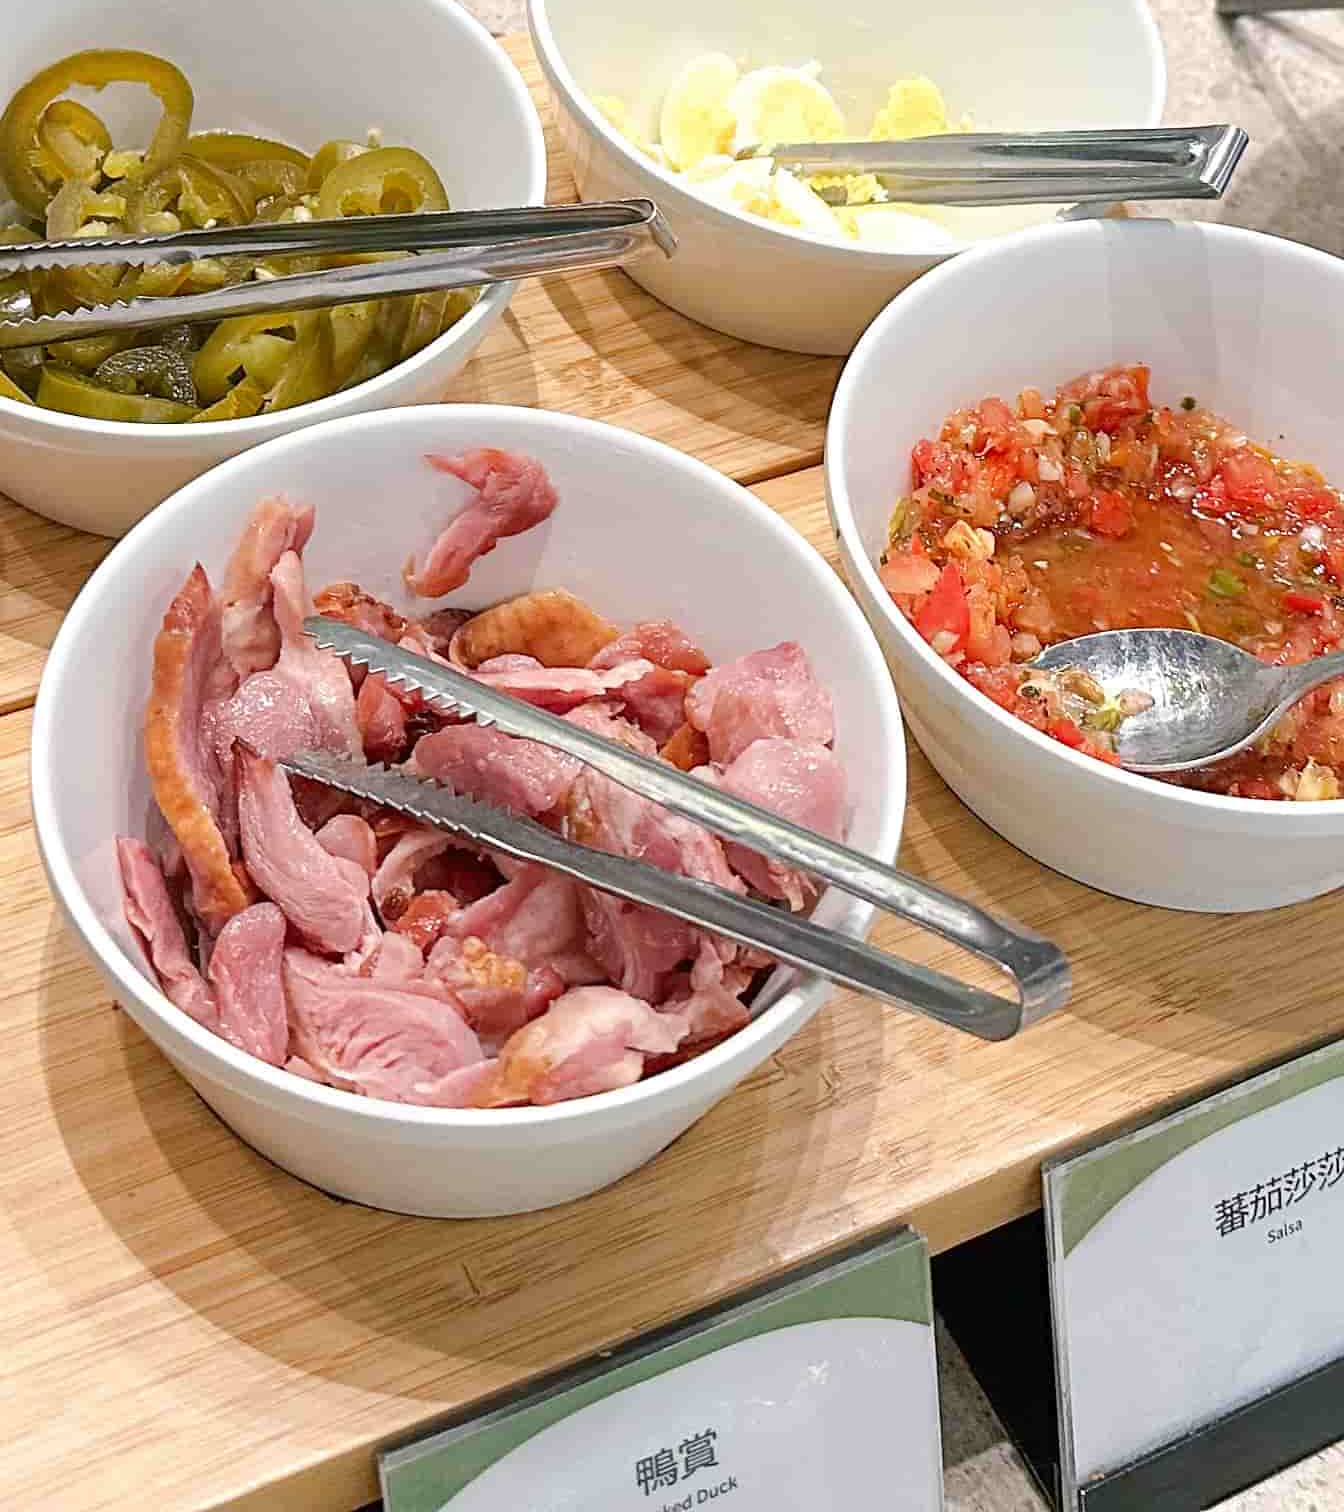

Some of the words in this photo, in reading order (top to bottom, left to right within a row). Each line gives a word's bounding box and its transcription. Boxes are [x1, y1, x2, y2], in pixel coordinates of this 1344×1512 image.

[1267, 1219, 1303, 1244] Salsa
[636, 1427, 719, 1496] 鴨賞
[697, 1474, 739, 1504] Duck
